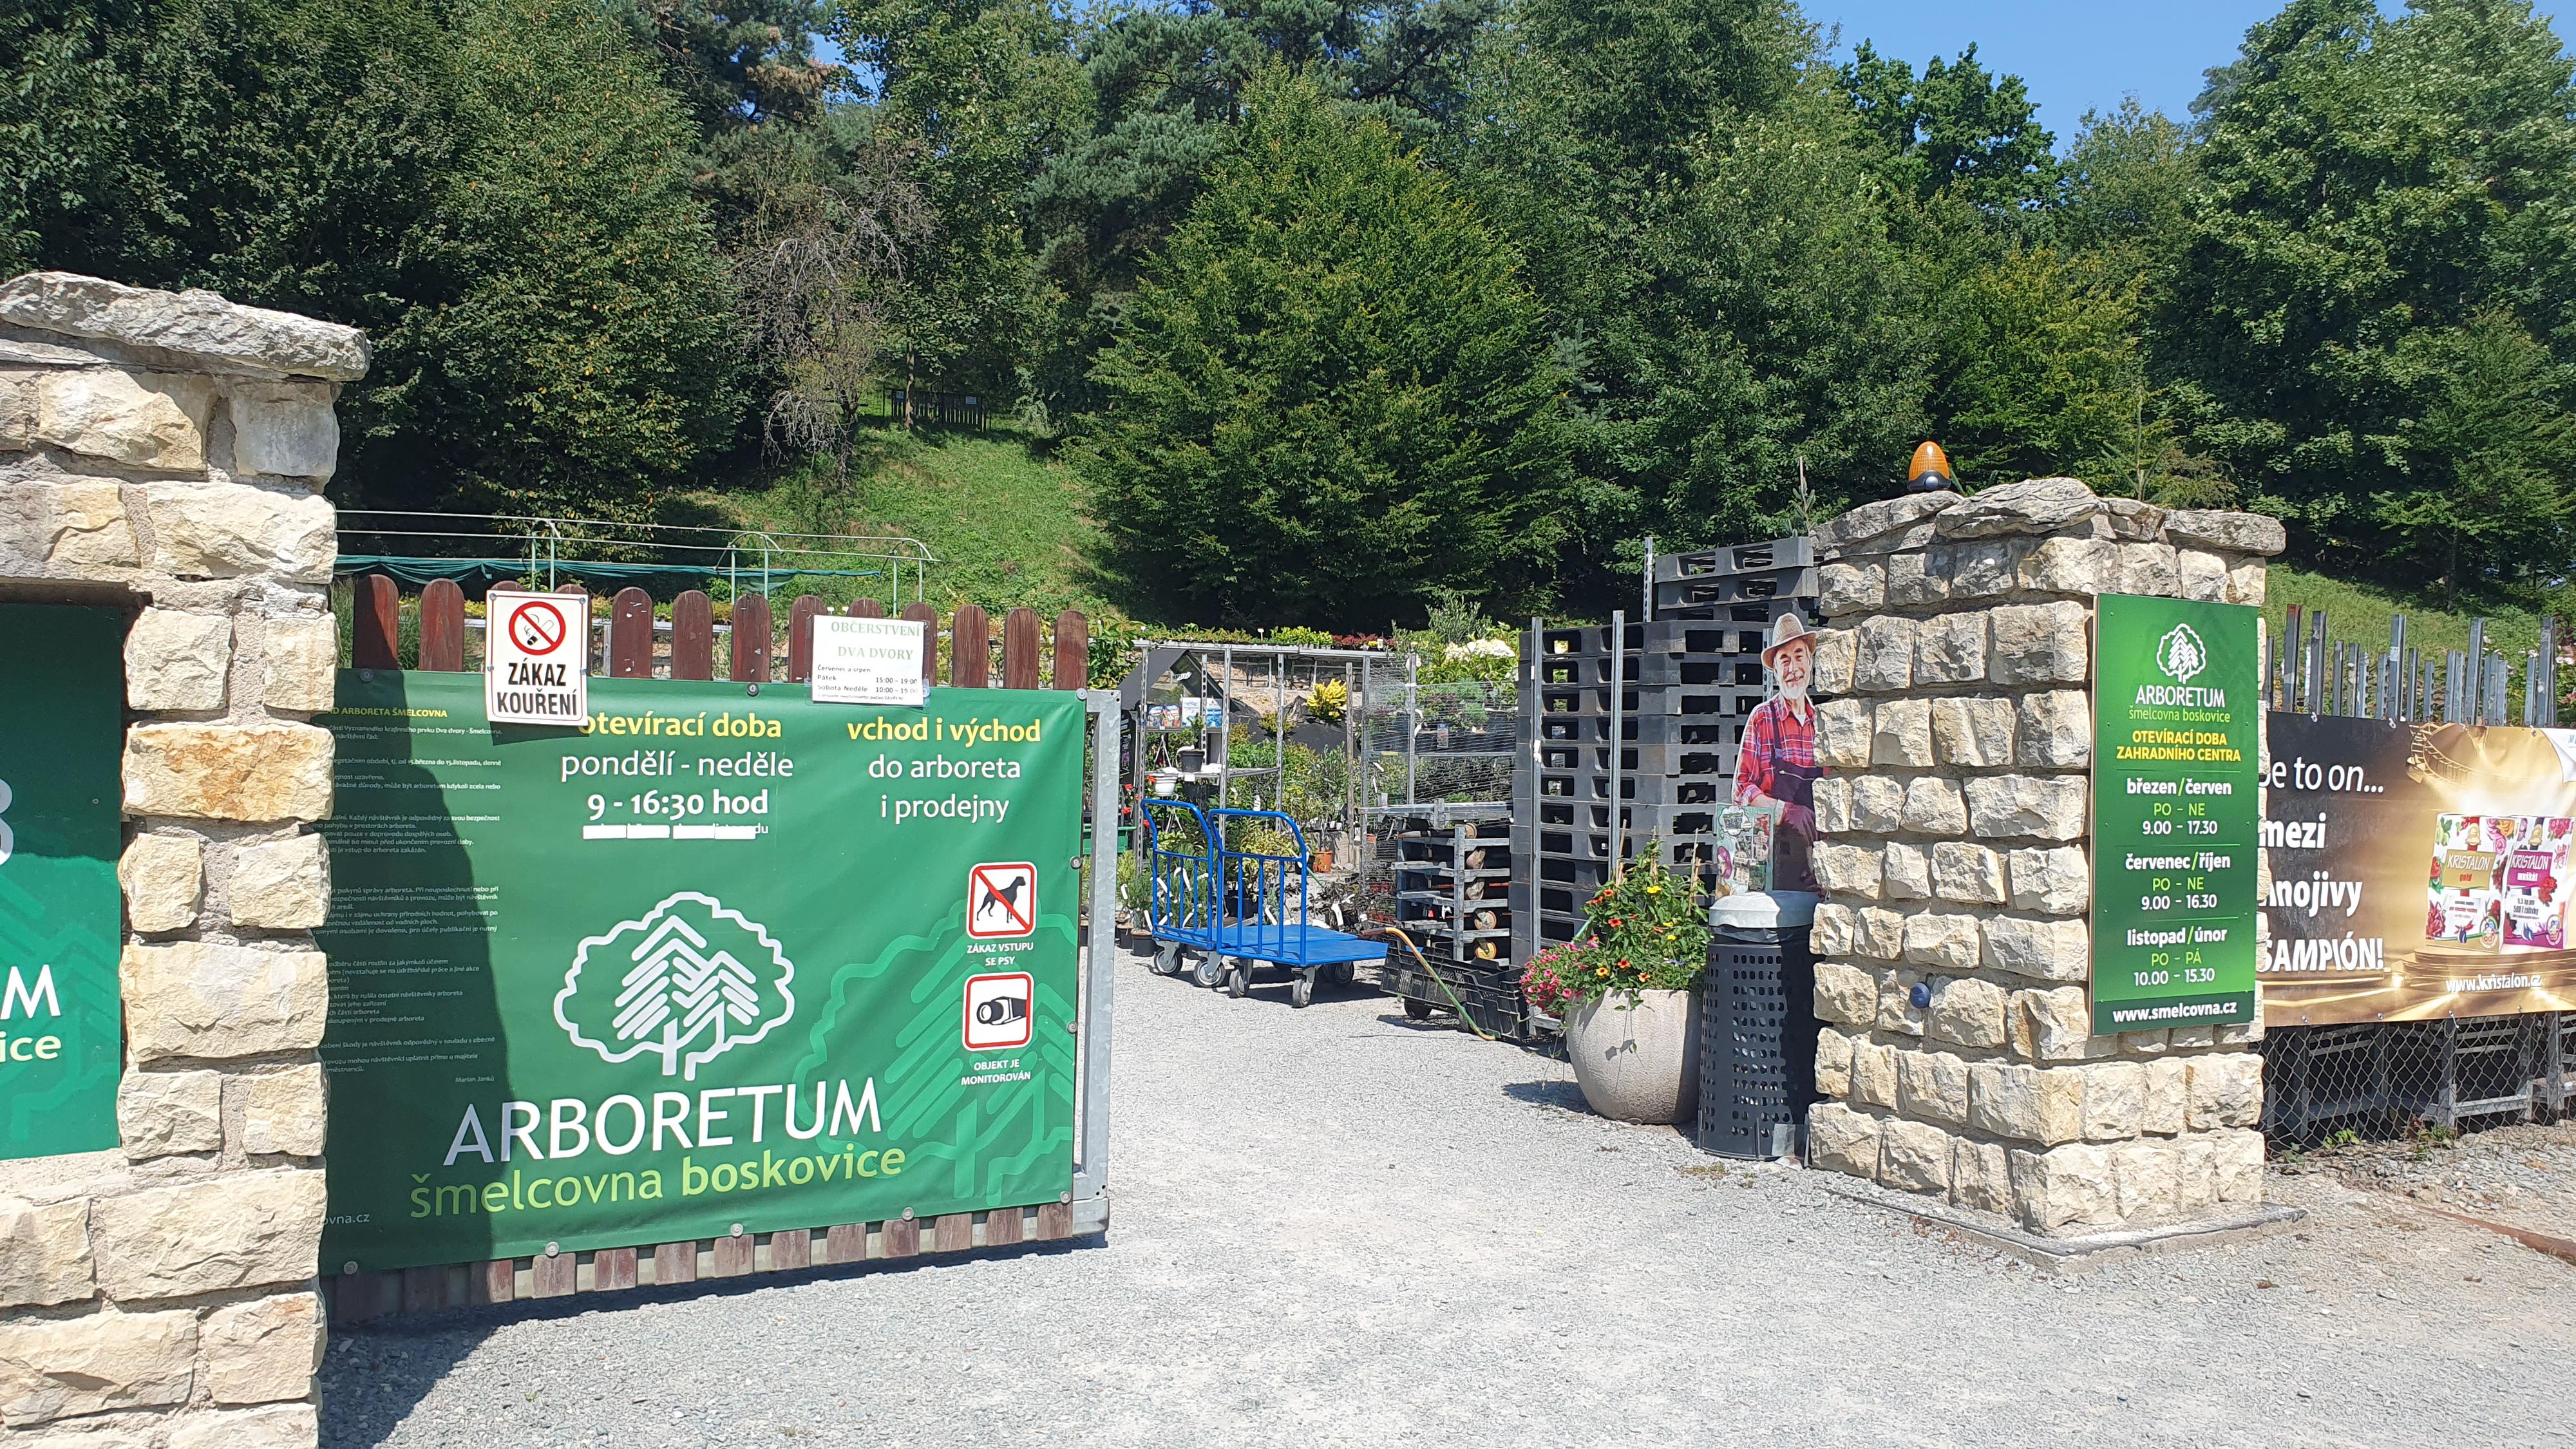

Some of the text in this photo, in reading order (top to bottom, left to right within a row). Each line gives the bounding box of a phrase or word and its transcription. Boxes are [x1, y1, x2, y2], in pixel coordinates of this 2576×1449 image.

[831, 621, 921, 636] OBČERSTVENÍ
[837, 646, 913, 660] DVA DVORY
[508, 658, 566, 687] ZÁKAZ
[497, 688, 577, 715] KOUŘENÍ
[2135, 685, 2226, 708] ARBORETUM
[392, 707, 448, 717] ŠMELCOVNA
[2128, 705, 2231, 723] šmelcovna boskovice
[578, 711, 782, 738] otevírací doba
[848, 716, 1041, 748] vchod i východ
[2132, 728, 2228, 746] OTEVÍRACÍ DOBA
[2116, 744, 2241, 761] ZAHRADNÍHO CENTRA
[561, 750, 676, 782] pondělí
[699, 752, 793, 777] neděle
[868, 754, 1021, 779] do arboreta
[2294, 757, 2322, 790] to
[2328, 764, 2383, 793] on...
[2126, 777, 2232, 797] březen/červen
[587, 794, 605, 820] 9
[630, 790, 705, 821] 16:30
[713, 789, 768, 814] hod
[881, 795, 1010, 825] i prodejny
[2154, 802, 2172, 817] PO
[2188, 802, 2205, 817] NE
[2142, 820, 2172, 835] 9.00
[2187, 820, 2219, 835] 17.30
[2259, 812, 2326, 848] mezi
[2125, 851, 2231, 873] červenec/říjen
[2447, 855, 2491, 871] KRISTALON
[2512, 854, 2549, 870] KRISTALON
[2152, 877, 2170, 891] PO
[2187, 876, 2204, 891] NE
[2141, 895, 2170, 910] 9.00
[2186, 894, 2217, 909] 16.30
[2126, 925, 2228, 948] listopad/únor
[967, 942, 1034, 954] ZÁKAZ VSTUPU
[2151, 952, 2169, 967] PO
[2186, 947, 2202, 964] PÁ
[985, 956, 1015, 966] SE PSY
[2134, 971, 2169, 986] 10.00
[2184, 968, 2215, 983] 15.30
[2446, 972, 2543, 992] www.kristalon.cz
[2112, 1002, 2237, 1023] www.smelcovna.cz
[974, 1059, 1020, 1071] OBJEKT JE
[961, 1070, 1031, 1086] MONITOROVÁN
[442, 1077, 882, 1166] ARBORETUM
[410, 1142, 906, 1219] šmelcovna boskovice
